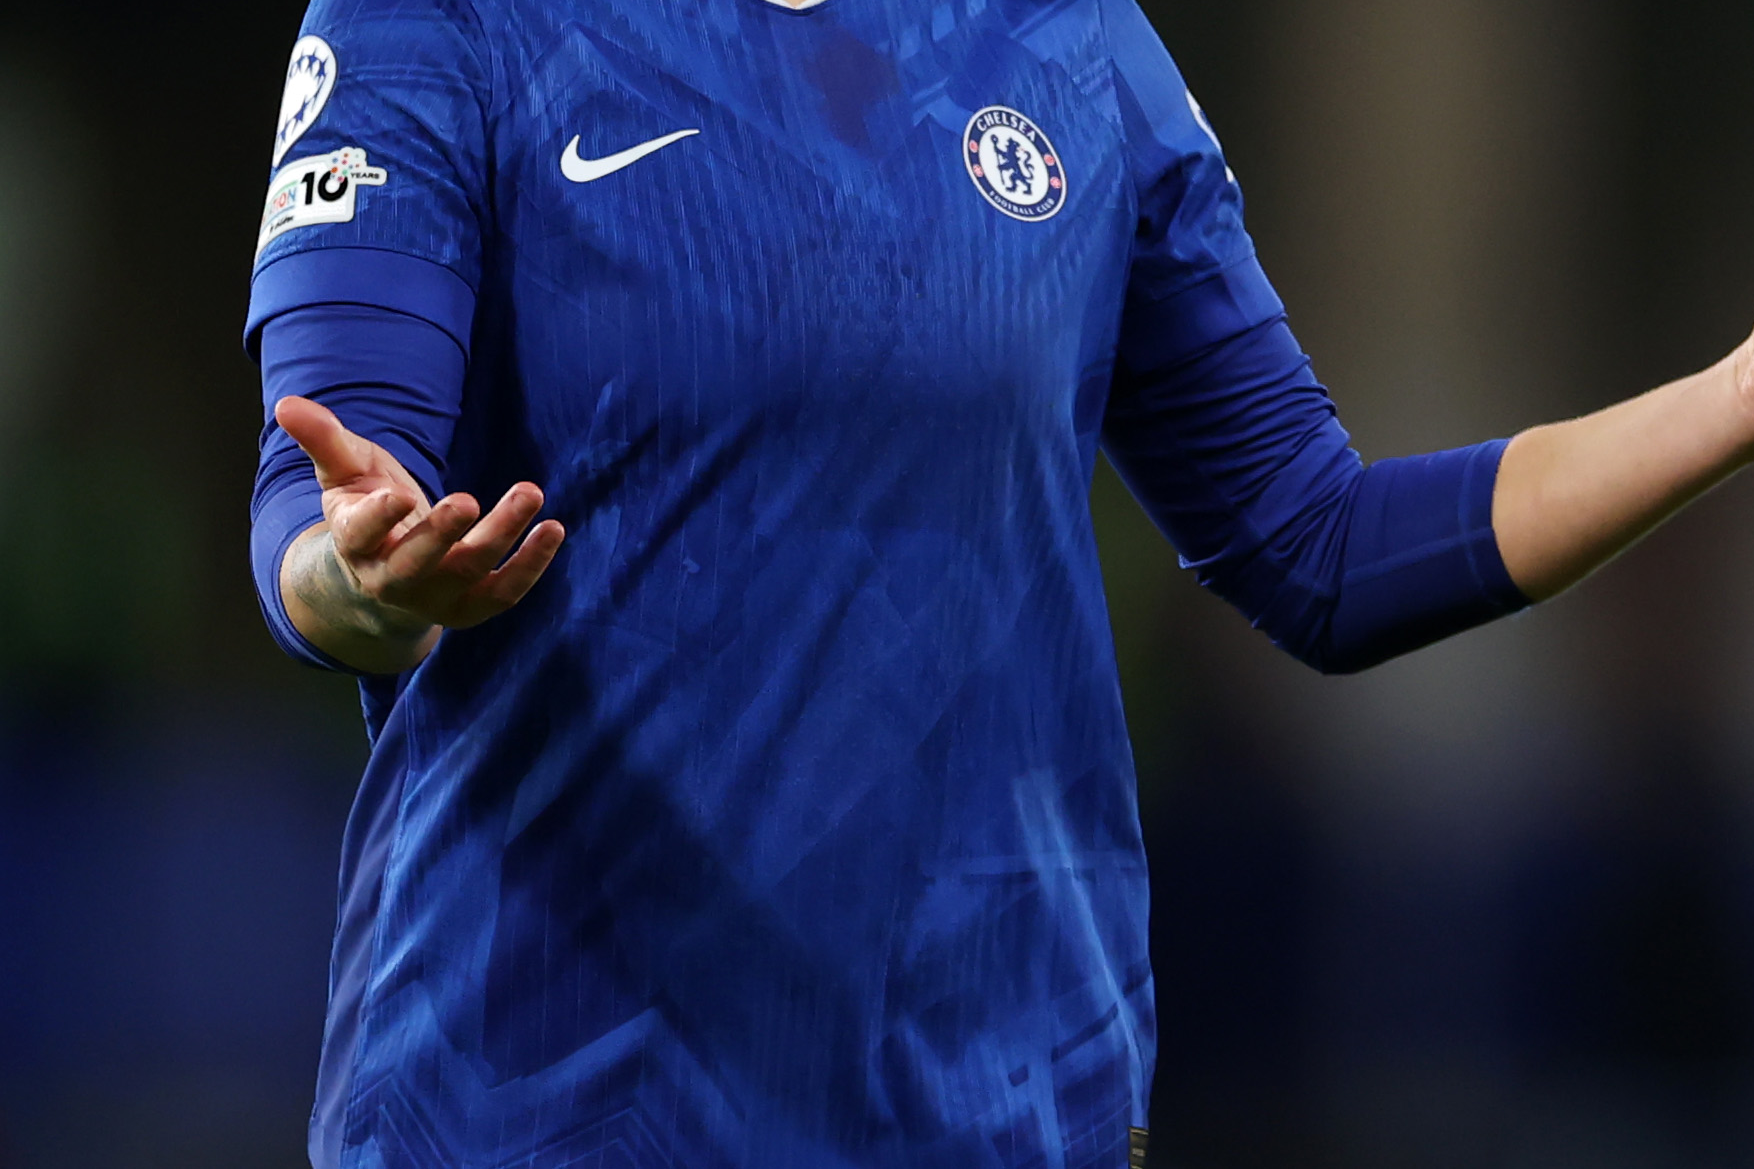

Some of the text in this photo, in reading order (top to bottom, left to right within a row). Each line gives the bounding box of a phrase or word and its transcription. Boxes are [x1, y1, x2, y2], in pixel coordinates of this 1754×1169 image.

[976, 111, 1036, 142] CHELSEA
[301, 167, 348, 205] 10
[989, 190, 1056, 215] FOOTBALL CLUB
